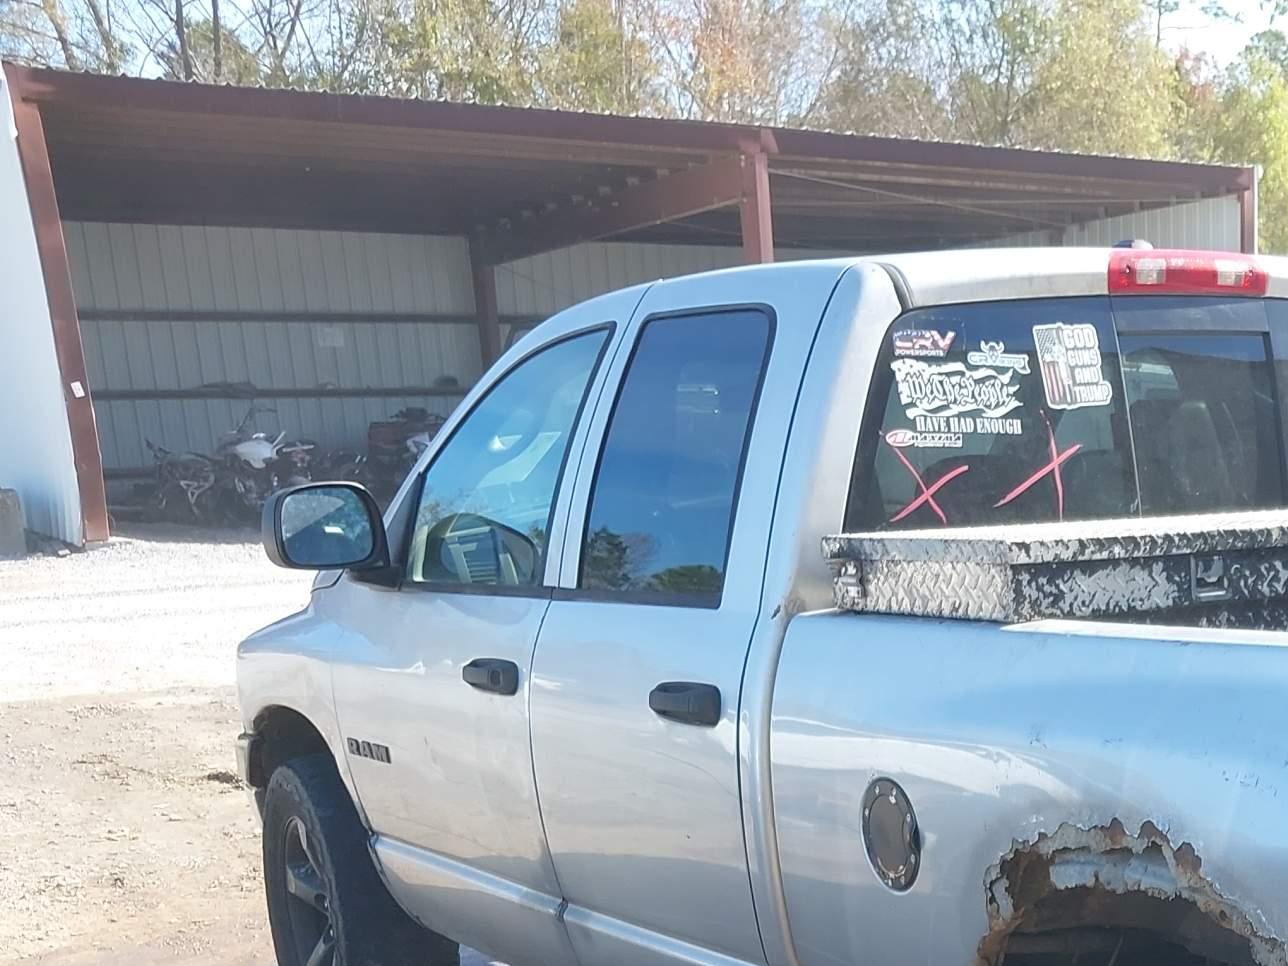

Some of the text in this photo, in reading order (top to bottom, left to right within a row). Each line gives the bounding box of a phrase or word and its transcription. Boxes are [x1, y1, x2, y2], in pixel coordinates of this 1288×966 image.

[1063, 328, 1092, 349] GOD
[894, 349, 944, 357] POWERSPORTS
[1067, 350, 1099, 367] GUNS
[1074, 367, 1099, 384] AND
[1073, 384, 1110, 402] TRUMP
[915, 416, 1022, 435] HAVE HAD ENOUGH
[346, 737, 391, 765] RAM
